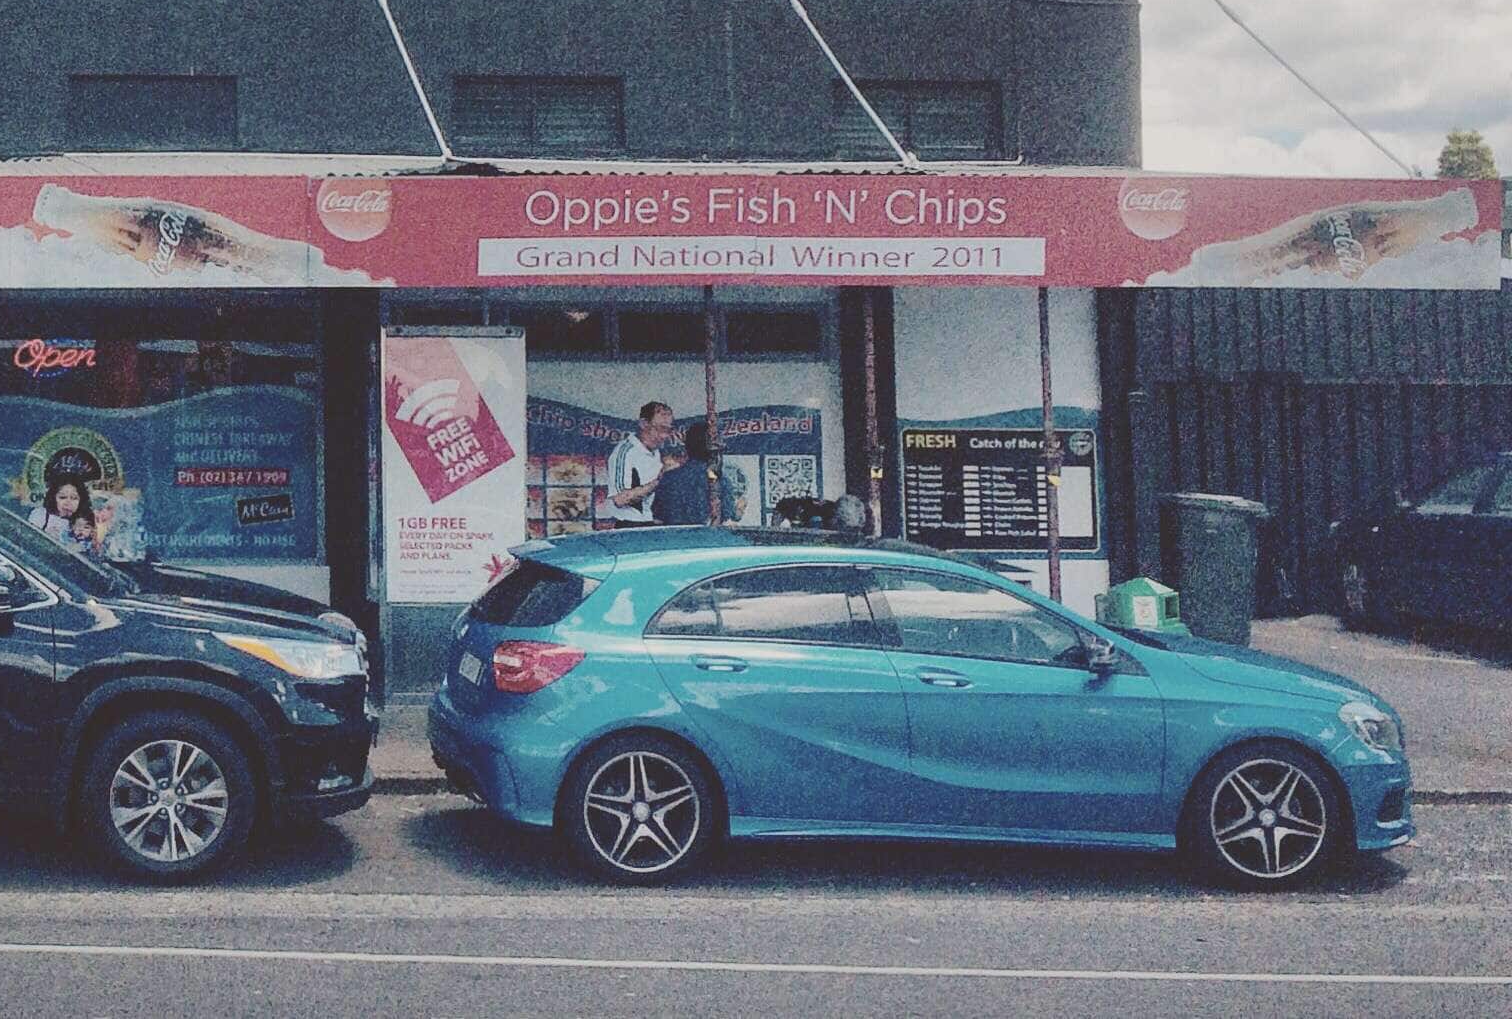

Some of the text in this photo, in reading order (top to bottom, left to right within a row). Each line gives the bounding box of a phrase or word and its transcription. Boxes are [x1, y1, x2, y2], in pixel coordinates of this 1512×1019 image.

[525, 189, 691, 230] Oppie's
[708, 187, 796, 224] Fish
[885, 188, 1008, 230] Chips
[516, 244, 1002, 268] Grand National Winner 2011
[14, 339, 96, 377] Open
[427, 416, 471, 450] FREE
[720, 412, 813, 437] Zealand
[906, 434, 956, 447] FRESH
[969, 437, 1002, 449] Catch
[1004, 437, 1017, 449] of
[1018, 437, 1040, 449] the
[445, 450, 489, 483] ZONE
[398, 517, 467, 529] 1GB FREE
